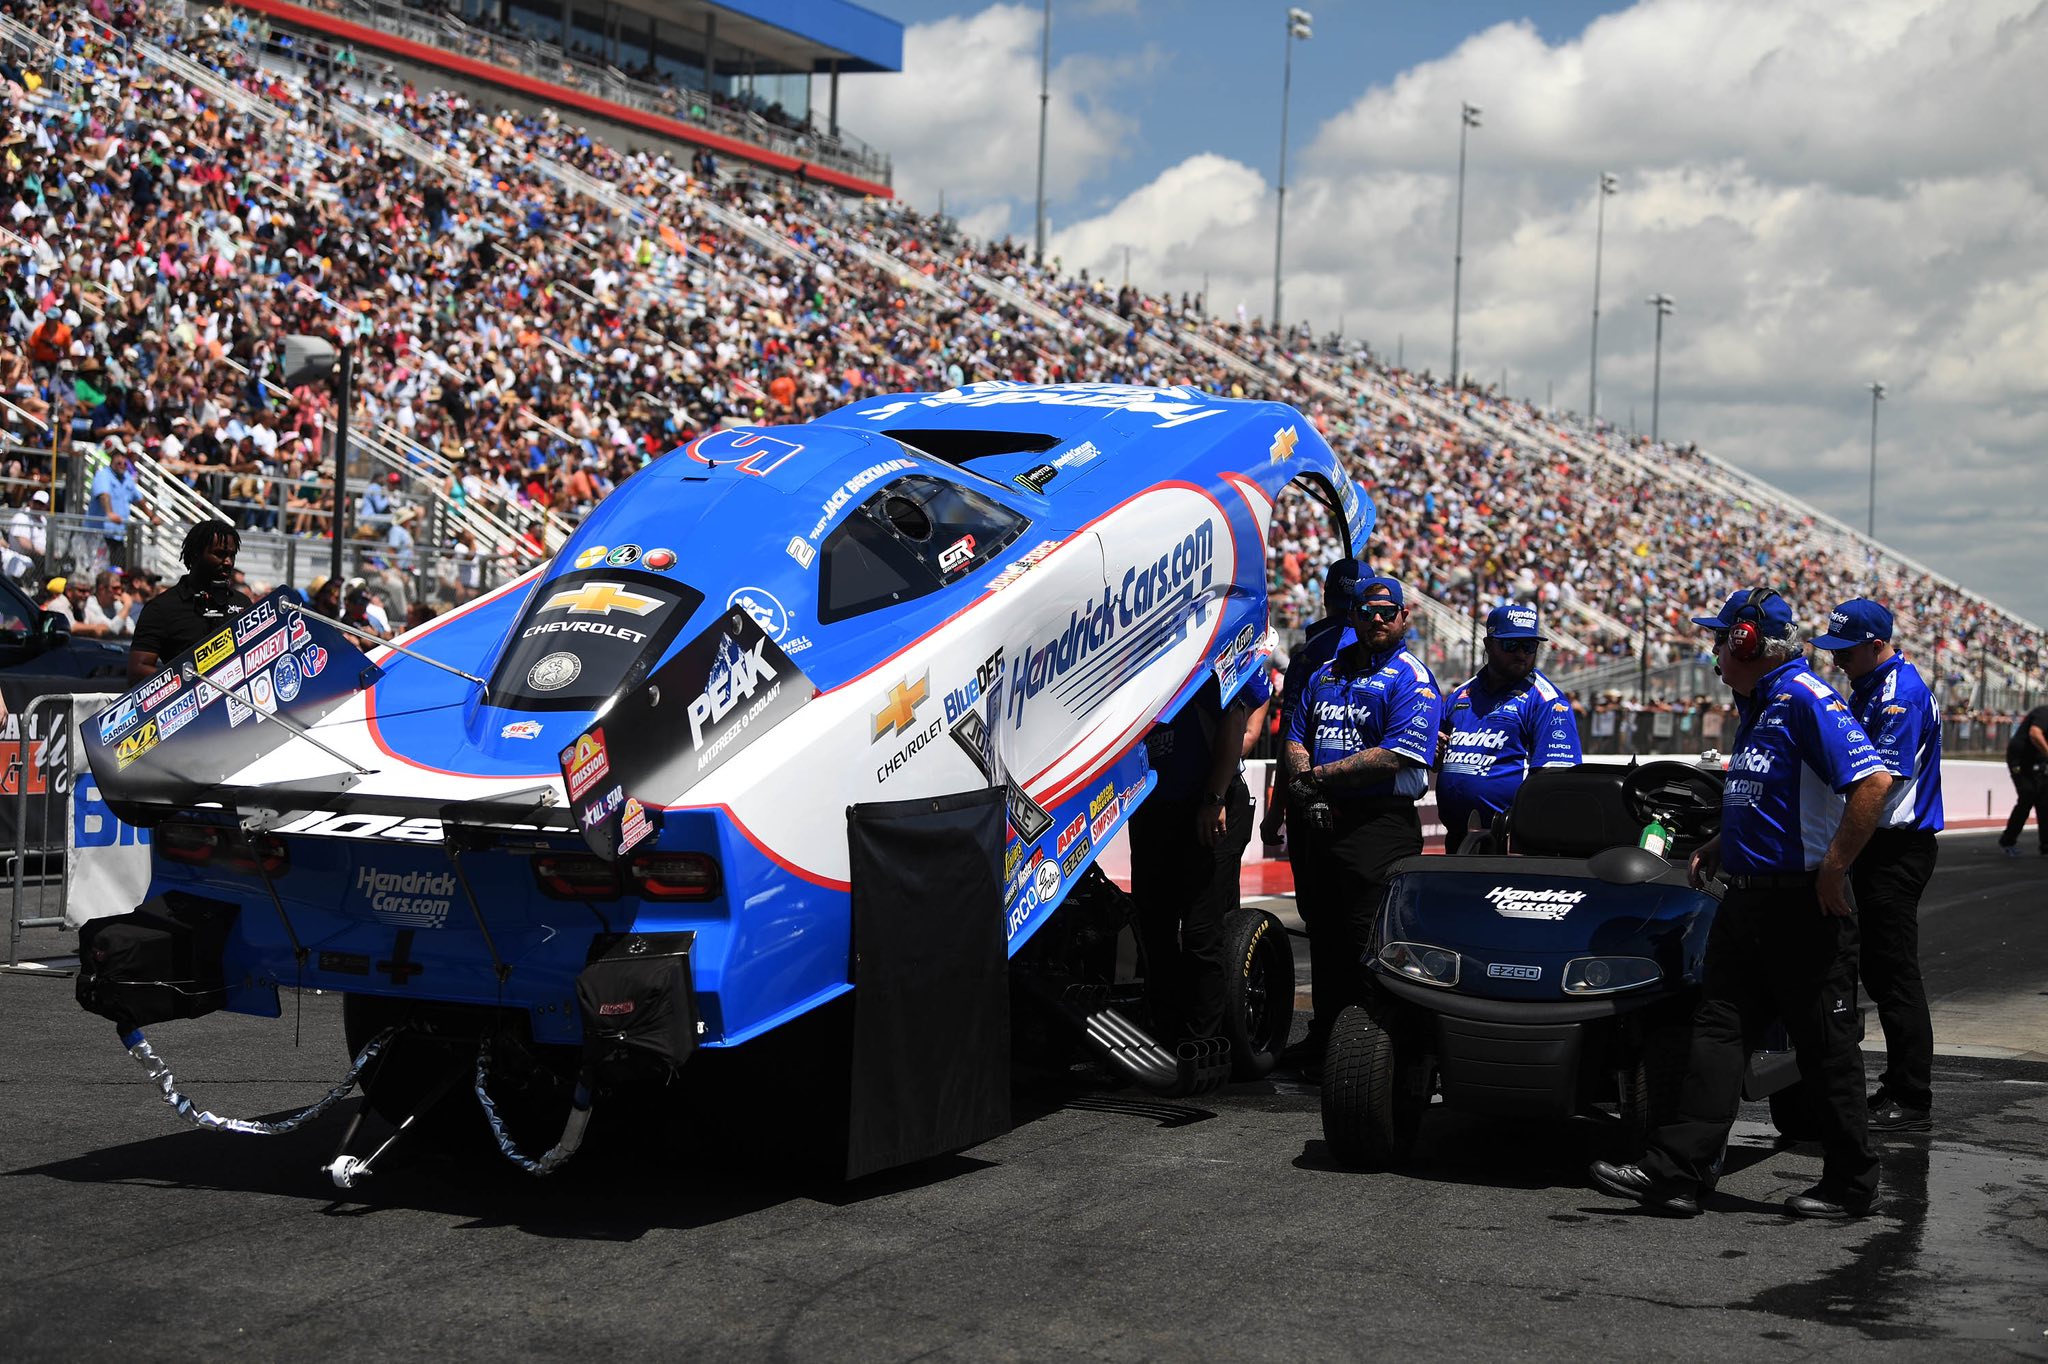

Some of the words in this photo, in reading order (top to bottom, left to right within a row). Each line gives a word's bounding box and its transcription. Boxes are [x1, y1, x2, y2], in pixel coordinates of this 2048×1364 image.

[822, 491, 852, 521] JACK
[848, 459, 903, 495] BECKMAN
[786, 536, 816, 570] 2
[236, 602, 276, 638] JESEL
[522, 621, 647, 643] CHEVROLET
[1007, 518, 1213, 729] HendrickCars.com
[196, 635, 224, 663] BME
[247, 634, 281, 674] MANLEY
[780, 635, 809, 652] WELL
[787, 641, 813, 655] TOOLS
[135, 670, 173, 703] LINCOLN
[146, 680, 178, 709] WELDERS
[687, 635, 777, 752] PEAK
[103, 715, 137, 745] CARRILLO
[698, 718, 742, 771] ANTIFREEZE
[749, 681, 781, 721] COOLANT
[877, 718, 942, 783] CHEVROLET
[1851, 754, 1882, 769] GOODYEA
[592, 802, 606, 824] ALL
[606, 785, 625, 810] STAR
[1093, 800, 1118, 841] SIMPSON
[1058, 814, 1086, 853] ARP
[357, 866, 456, 897] Hendrick
[1484, 886, 1587, 904] Hendrick
[372, 891, 450, 916] Cars.com
[1007, 886, 1038, 941] URCO
[1496, 898, 1574, 915] Cars.com
[1243, 919, 1269, 977] GOODYEAR
